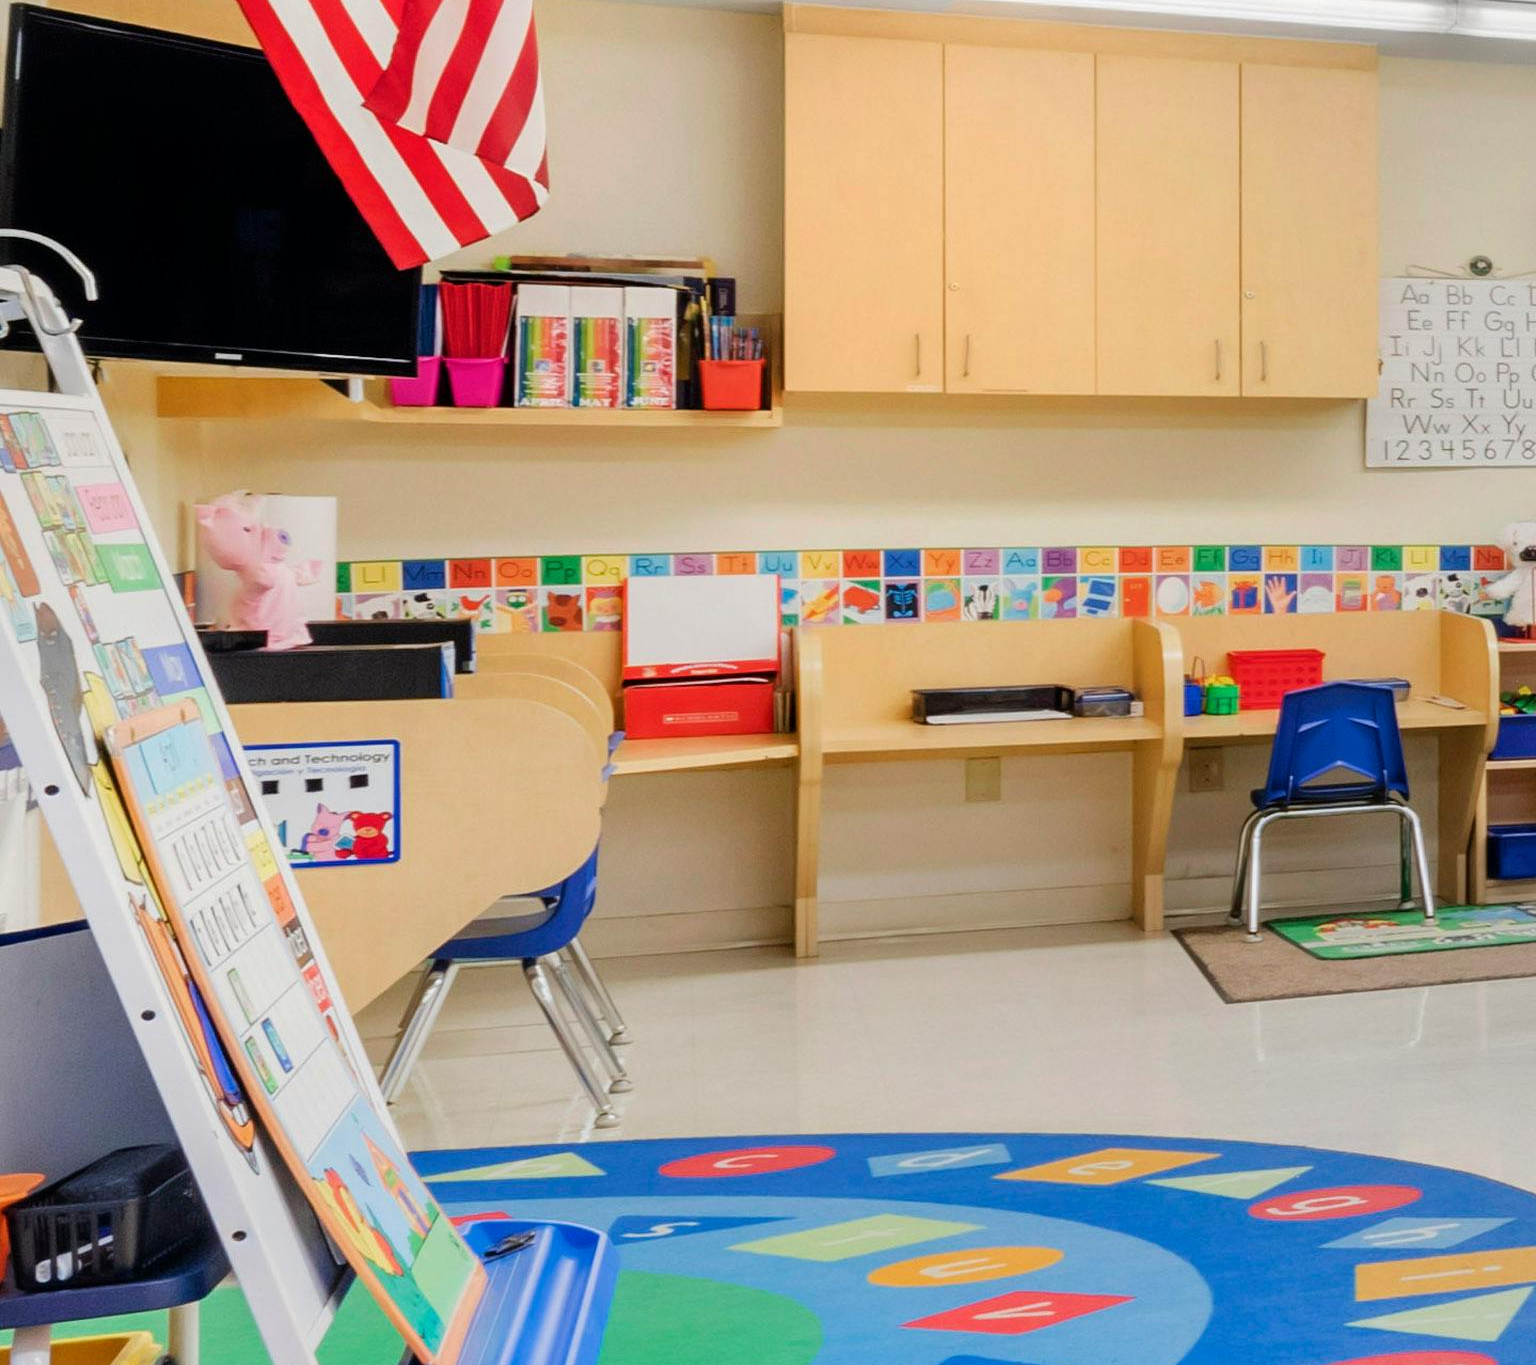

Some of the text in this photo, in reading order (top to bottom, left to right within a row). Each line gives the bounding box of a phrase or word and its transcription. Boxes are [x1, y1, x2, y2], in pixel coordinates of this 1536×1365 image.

[1401, 286, 1429, 305] Aa
[1447, 286, 1472, 305] Bb
[1490, 286, 1516, 306] Cc
[1408, 311, 1432, 331] Ee
[1447, 311, 1470, 330] Ff
[1484, 311, 1515, 340] Gg
[1389, 336, 1409, 356] Ii
[1423, 338, 1442, 365] Jj
[1458, 337, 1486, 357] Kk
[1501, 338, 1520, 357] Ll
[1412, 363, 1444, 383] Nn
[1455, 363, 1486, 383] Oo
[1496, 363, 1519, 392] Pp
[1391, 389, 1416, 408] Rr
[1431, 389, 1454, 408] Ss
[1466, 389, 1484, 408] Tt
[1503, 389, 1533, 409] Uu
[1403, 415, 1450, 433] Ww
[1462, 415, 1490, 433] Xx
[1502, 415, 1526, 442] Yy
[1384, 440, 1388, 459] 1
[1396, 441, 1410, 460] 2
[1418, 440, 1432, 460] 3
[1441, 440, 1455, 460] 4
[1462, 440, 1474, 460] 5
[1484, 440, 1496, 460] 6
[1504, 440, 1514, 460] 7
[1522, 440, 1536, 460] 8
[453, 564, 486, 580] Nn
[545, 561, 576, 584] Pp
[586, 560, 621, 583] Qq
[636, 558, 663, 575] Rr
[681, 557, 705, 574] Ss
[765, 556, 793, 572] Uu
[807, 556, 832, 570] Vv
[927, 553, 956, 573] Yy
[968, 552, 992, 569] Zz
[1006, 551, 1037, 568] Aa
[1047, 551, 1073, 568] Bb
[1084, 551, 1110, 566] Cc
[1161, 551, 1185, 566] Ee
[1376, 549, 1398, 564] Kk
[271, 752, 389, 765] and Technology
[713, 1154, 780, 1170] c
[897, 1149, 994, 1169] d
[1067, 1160, 1134, 1176] e
[1266, 1195, 1369, 1216] g
[1364, 1222, 1460, 1246] h
[919, 1257, 1007, 1280] u
[971, 1301, 1055, 1320] v
